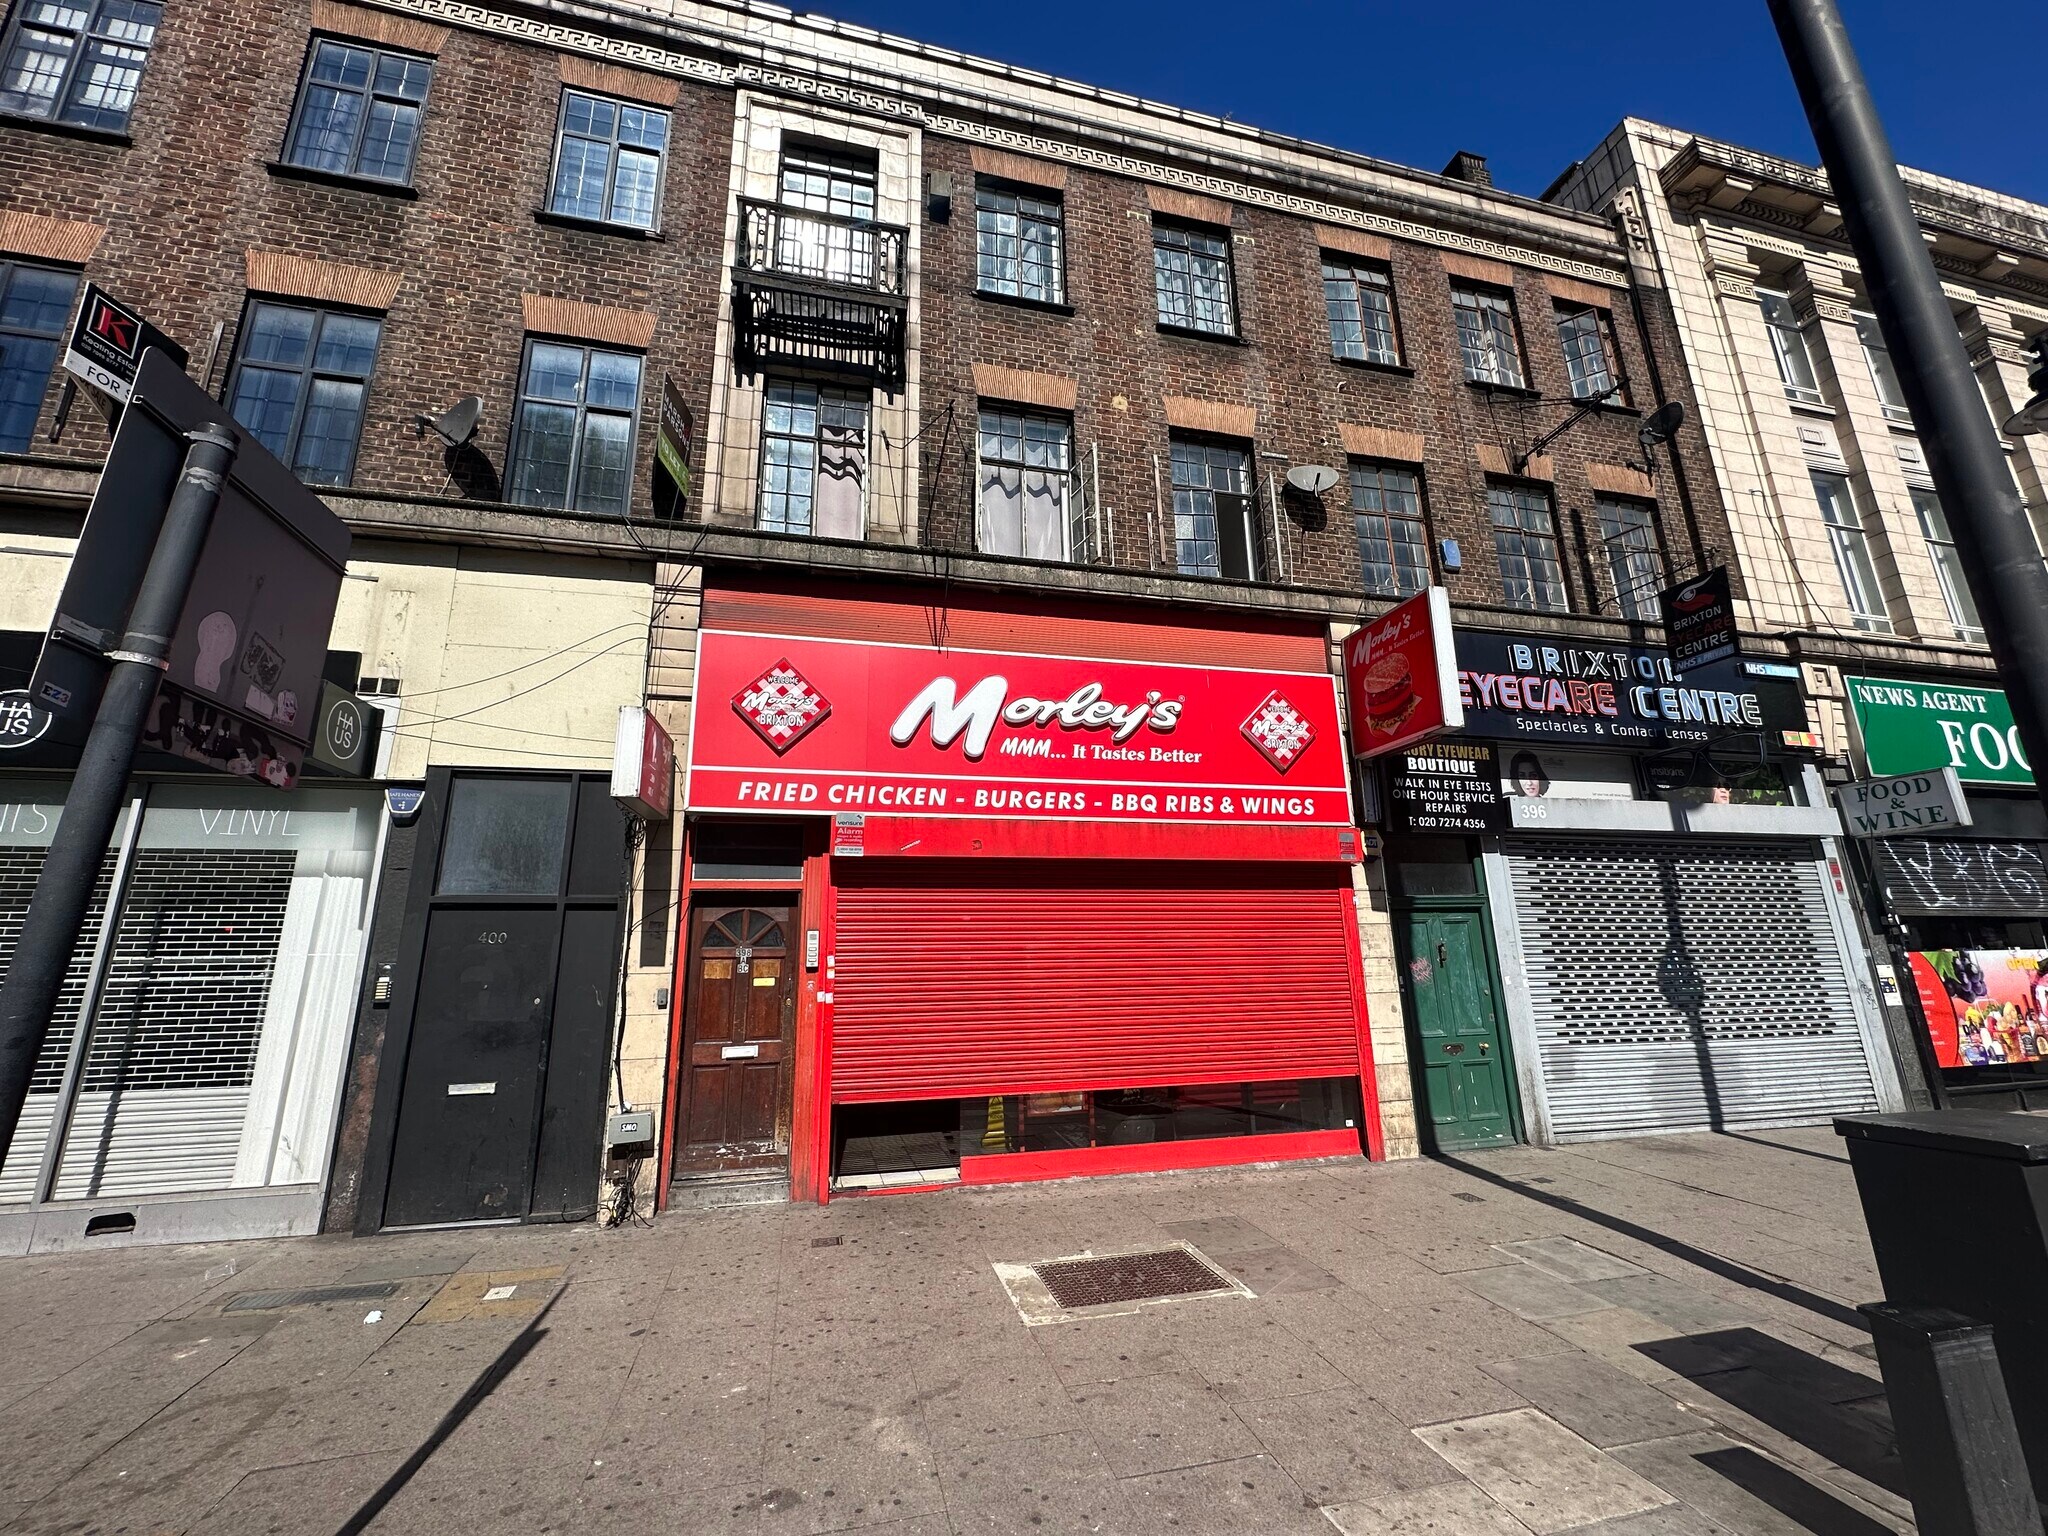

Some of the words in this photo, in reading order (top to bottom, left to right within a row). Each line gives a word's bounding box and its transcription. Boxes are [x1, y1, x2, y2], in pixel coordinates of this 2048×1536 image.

[94, 305, 134, 350] K
[83, 334, 116, 359] Keating
[118, 355, 138, 372] Estat
[87, 366, 120, 393] FOR
[1673, 605, 1722, 631] BRIXTON
[1352, 613, 1412, 667] Morley's
[1668, 615, 1734, 647] EYECARE
[1675, 630, 1729, 658] CENTRE
[1676, 656, 1697, 671] NHS
[1703, 645, 1733, 661] PRIVATE
[1745, 663, 1766, 674] NHS
[767, 675, 799, 685] WELCOME
[740, 691, 814, 711] Morley's
[1458, 671, 1618, 716] EYECARE
[1632, 686, 1763, 726] CENTRE
[1855, 685, 1917, 707] NEWS
[1922, 691, 1987, 713] AGENT
[759, 714, 804, 727] BRIXTON
[890, 675, 1183, 758] Morley's
[1516, 717, 1588, 733] Spectacles
[1595, 723, 1604, 734] &
[1664, 727, 1708, 740] Lenses
[1000, 737, 1066, 758] MMM...
[1073, 744, 1086, 758] It
[1091, 745, 1145, 761] Tastes
[1150, 747, 1202, 763] Better
[1436, 745, 1490, 760] EYEWEAR
[1407, 757, 1476, 773] BOUTIQUE
[1394, 777, 1424, 788] WALK
[1429, 779, 1439, 789] IN
[1444, 780, 1461, 790] EYE
[1465, 781, 1491, 791] TESTS
[1855, 777, 1931, 802] FOOD
[738, 781, 818, 802] FRIED
[828, 784, 947, 806] CHICKEN
[974, 789, 1086, 810] BURGERS
[1112, 793, 1158, 813] BBQ
[1166, 794, 1214, 814] RIBS
[1219, 796, 1234, 813] &
[1241, 797, 1315, 815] WINGS
[1393, 789, 1416, 799] ONE
[1420, 790, 1450, 801] HOUR
[1453, 792, 1495, 803] SERVICE
[1890, 797, 1906, 810] &
[1425, 803, 1467, 814] REPAIRS
[1521, 805, 1547, 819] 396
[1854, 805, 1948, 832] WINE
[199, 807, 300, 836] VINYL
[837, 827, 863, 835] Alarm
[1408, 817, 1416, 826] T:
[1418, 817, 1436, 827] 020
[1439, 818, 1461, 828] 7274
[1463, 819, 1486, 829] 4356
[478, 931, 508, 944] 400
[736, 949, 752, 957] 398
[740, 957, 747, 965] A
[2006, 957, 2040, 971] OPEN
